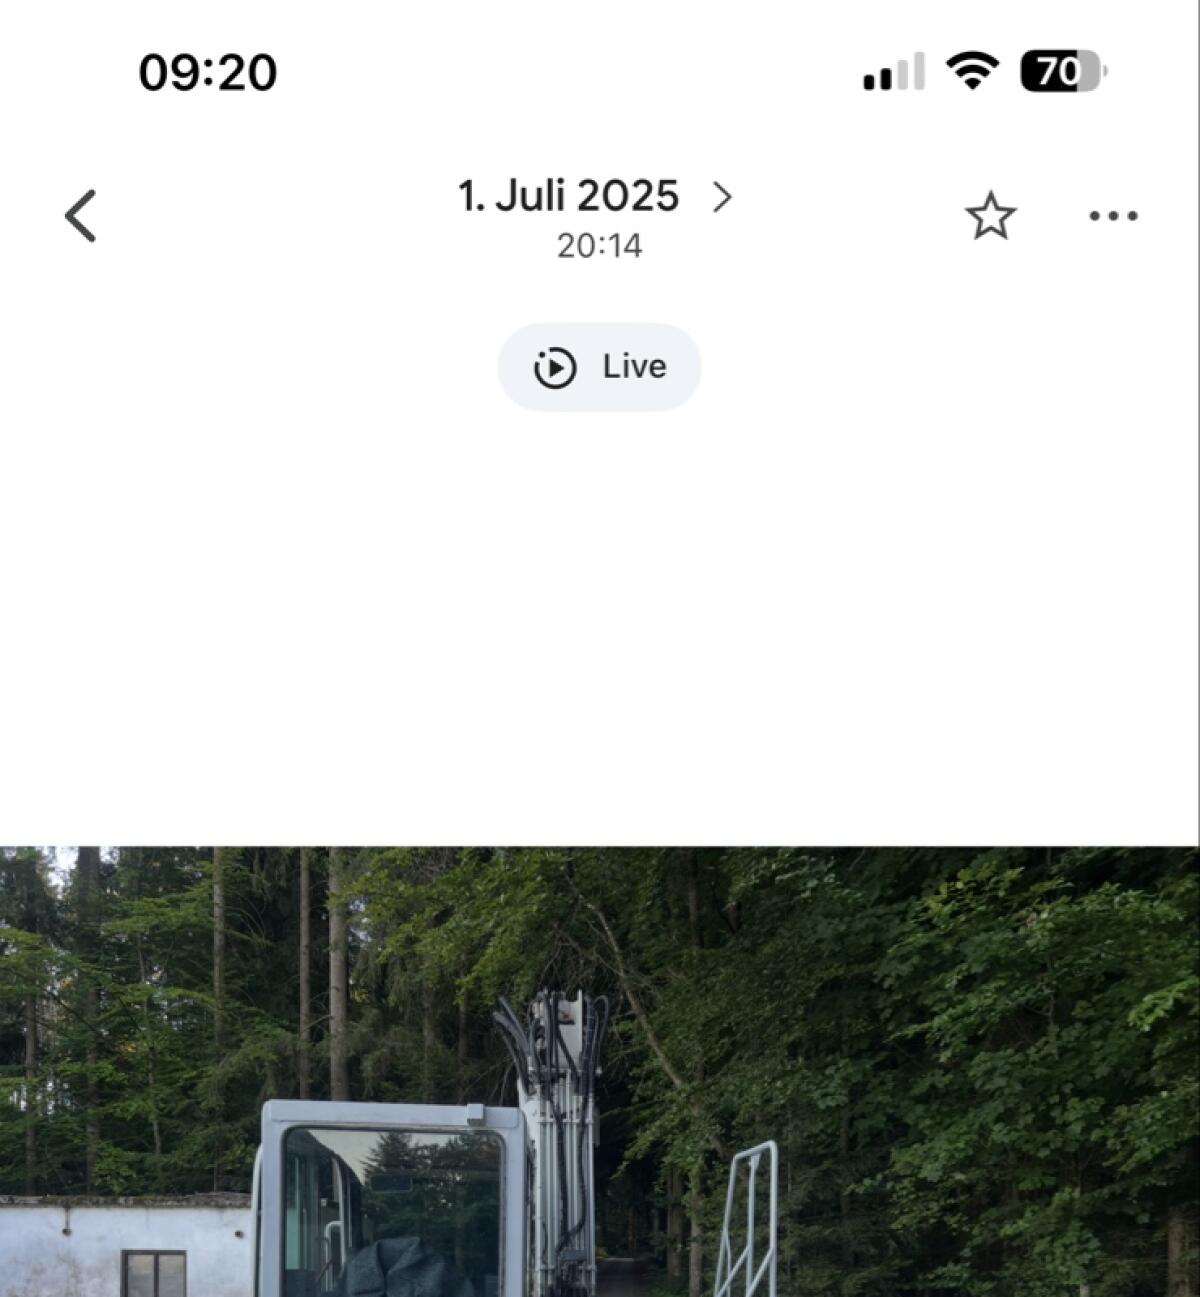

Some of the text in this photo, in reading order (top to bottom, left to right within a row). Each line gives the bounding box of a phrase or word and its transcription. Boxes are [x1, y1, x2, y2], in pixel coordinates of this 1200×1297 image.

[138, 52, 278, 92] 09:20
[1037, 56, 1082, 86] 70
[458, 177, 679, 212] 1. Juli 2025
[557, 232, 643, 259] 20:14
[603, 351, 667, 379] Live
